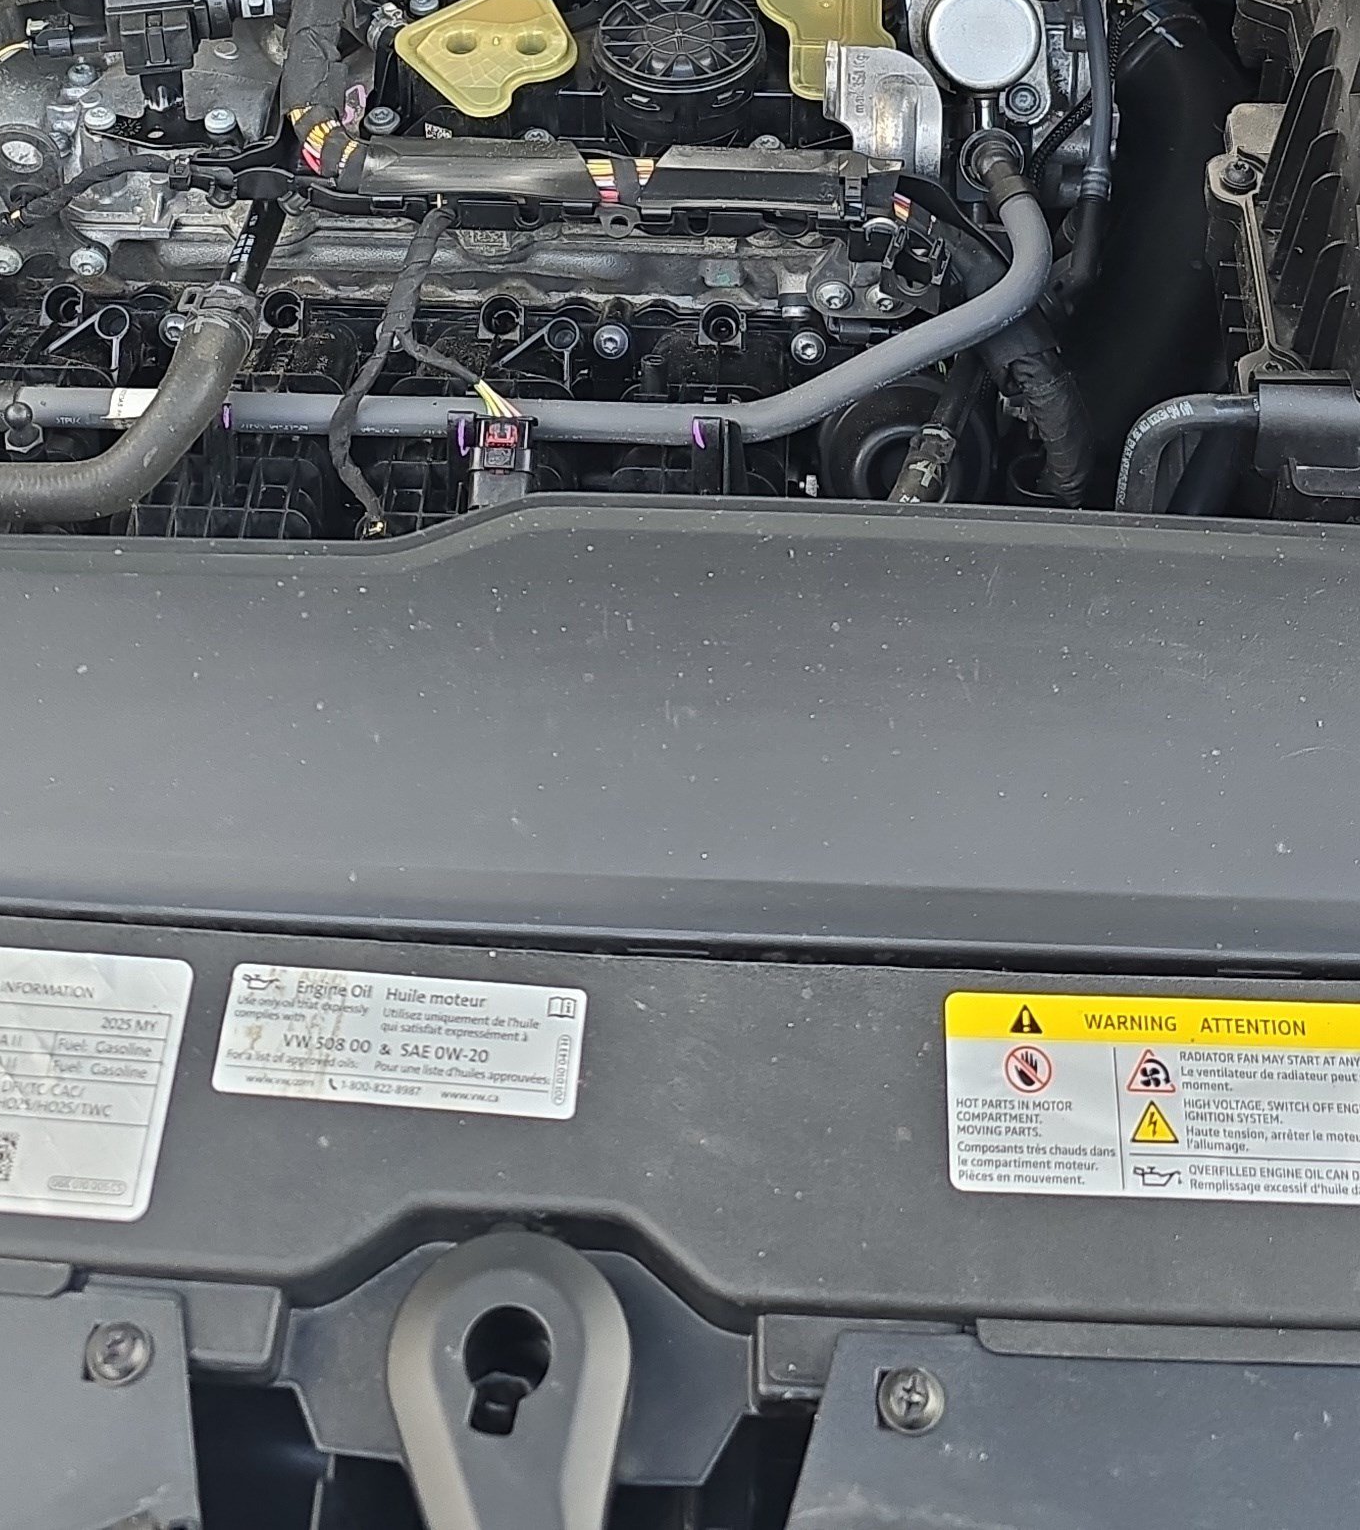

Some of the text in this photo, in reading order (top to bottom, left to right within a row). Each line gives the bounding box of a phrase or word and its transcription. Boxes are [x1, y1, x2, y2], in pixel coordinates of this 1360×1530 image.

[0, 981, 93, 999] INFORMATION
[296, 981, 373, 999] Engine Oil
[385, 988, 486, 1008] Huile moteur
[101, 1016, 132, 1031] 2025
[383, 1008, 540, 1029] Utilisez uniquement de l'huile
[1084, 1014, 1305, 1035] WARNING ATTENTION
[380, 1022, 398, 1032] qui
[400, 1024, 442, 1035] satisfait
[520, 1032, 528, 1042] à
[95, 1040, 152, 1057] Gasoline
[283, 1033, 489, 1063] VW 508 00 & SAE 0W-20
[272, 1052, 285, 1063] of
[1179, 1051, 1234, 1063] RADIATOR
[1236, 1052, 1259, 1064] FAN
[1261, 1054, 1285, 1065] MAY
[1286, 1054, 1320, 1066] START
[1322, 1055, 1336, 1066] AT
[1338, 1056, 1360, 1067] ANY
[90, 1062, 147, 1079] Gasoline
[374, 1060, 399, 1072] Pour
[400, 1065, 421, 1075] une
[422, 1064, 444, 1076] liste
[445, 1066, 486, 1079] d'huiles
[1180, 1065, 1194, 1077] Le
[1196, 1067, 1257, 1079] ventilateur
[1259, 1068, 1274, 1080] de
[1276, 1069, 1328, 1081] radiateur
[1330, 1073, 1357, 1084] peut
[1181, 1081, 1232, 1091] moment.
[956, 1097, 1072, 1111] HOT PARTS IN MOTOR
[1183, 1098, 1211, 1110] HIGH
[1212, 1099, 1265, 1111] VOLTAGE,
[1267, 1100, 1310, 1112] SWITCH
[1312, 1101, 1334, 1113] OFF
[956, 1110, 1042, 1124] COMPARTMENT.
[1184, 1110, 1283, 1124] IGNITION SYSTEM.
[956, 1124, 1041, 1137] MOVING PARTS.
[1185, 1125, 1220, 1137] Haute
[1222, 1128, 1268, 1141] tension,
[1271, 1129, 1309, 1141] arrêter
[1312, 1129, 1323, 1141] le
[957, 1140, 1116, 1157] Composants très chauds dans
[1186, 1138, 1248, 1153] l'allumage.
[957, 1155, 1098, 1171] le compartiment moteur.
[958, 1169, 1085, 1185] Pièces en mouvement.
[1188, 1164, 1256, 1177] OVERFILLED
[1259, 1166, 1302, 1179] ENGINE
[1304, 1168, 1324, 1180] OIL
[1325, 1168, 1349, 1180] CAN
[1189, 1178, 1261, 1194] Remplissage
[1263, 1182, 1307, 1193] excessif
[1310, 1183, 1349, 1195] d'huile
